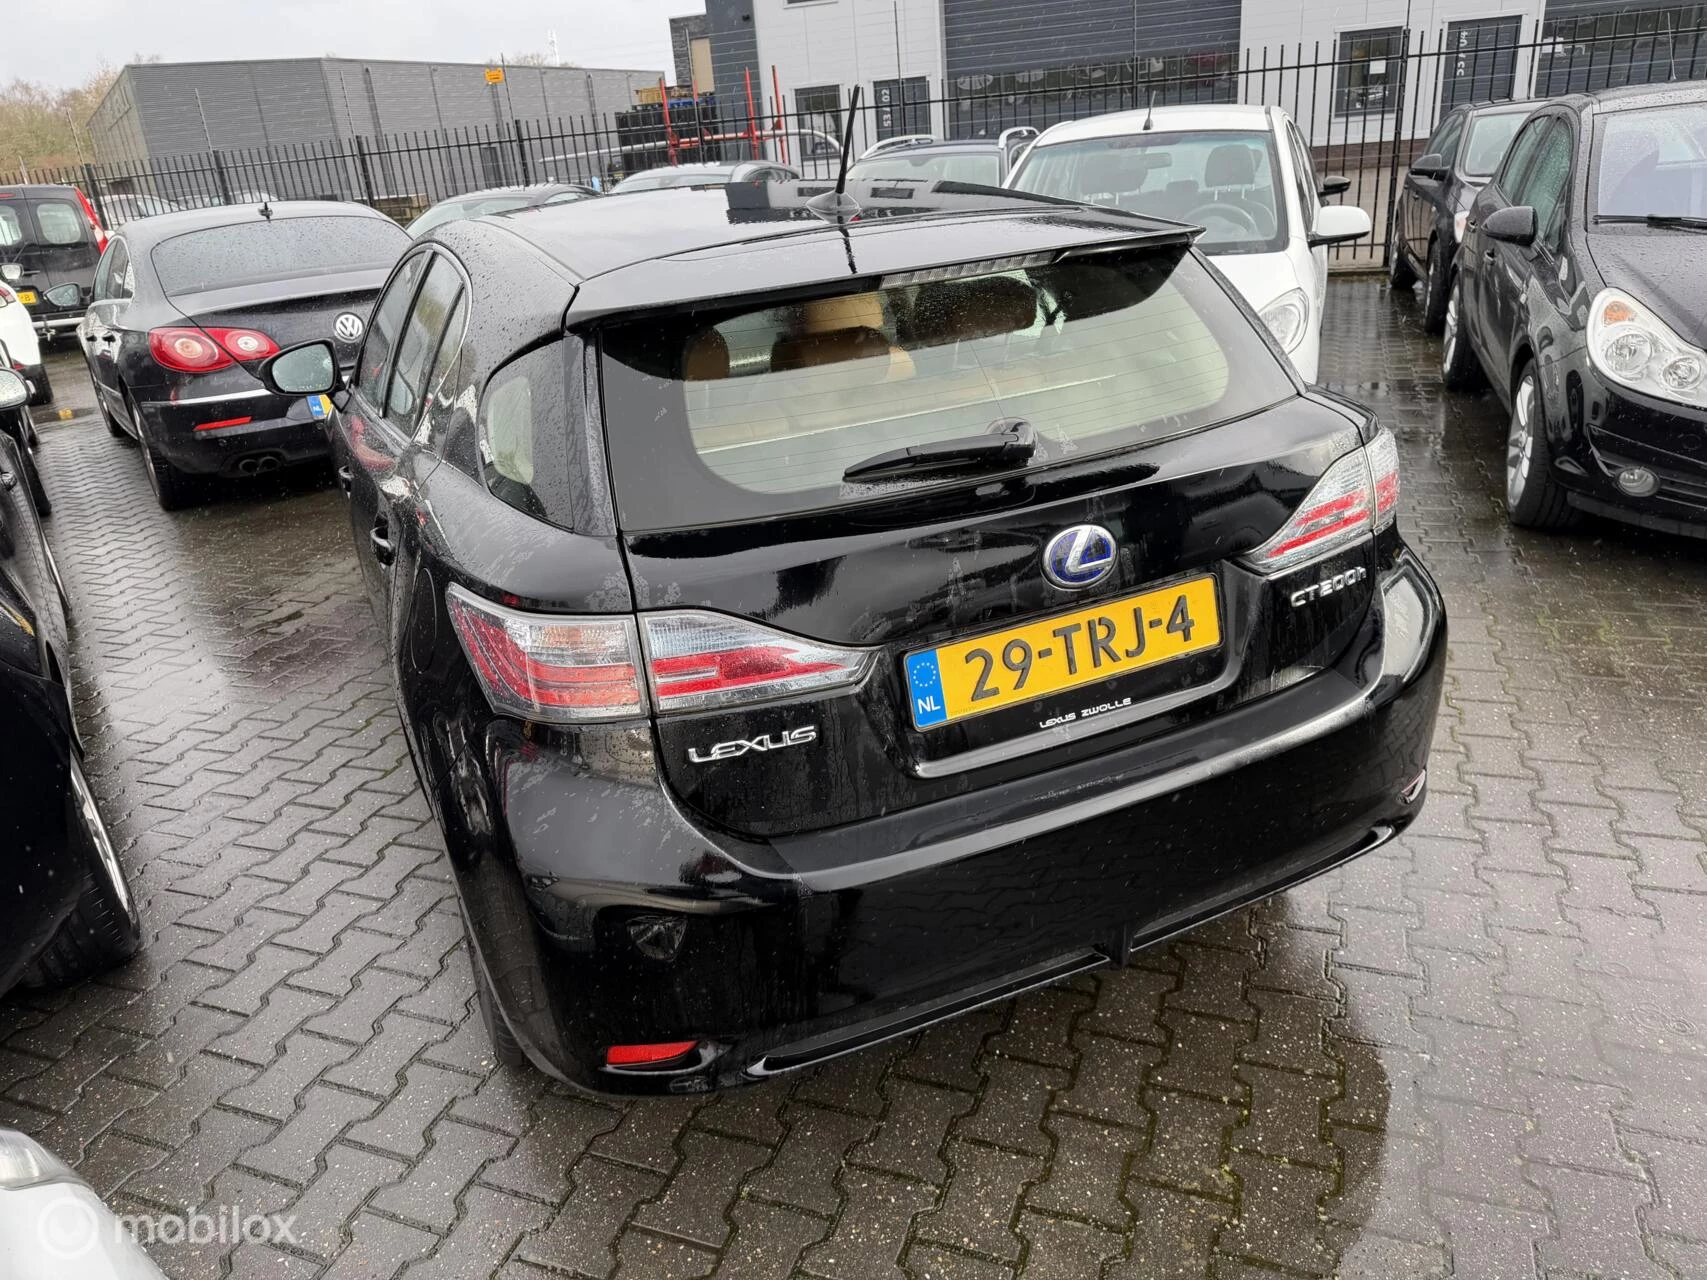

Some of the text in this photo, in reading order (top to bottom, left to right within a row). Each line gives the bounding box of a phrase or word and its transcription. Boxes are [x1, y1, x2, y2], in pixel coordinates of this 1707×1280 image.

[964, 594, 1195, 702] 29-TRJ-4
[917, 695, 941, 714] NL
[1039, 697, 1132, 728] LEXUS ZWOLLE
[688, 725, 817, 763] LEXUS
